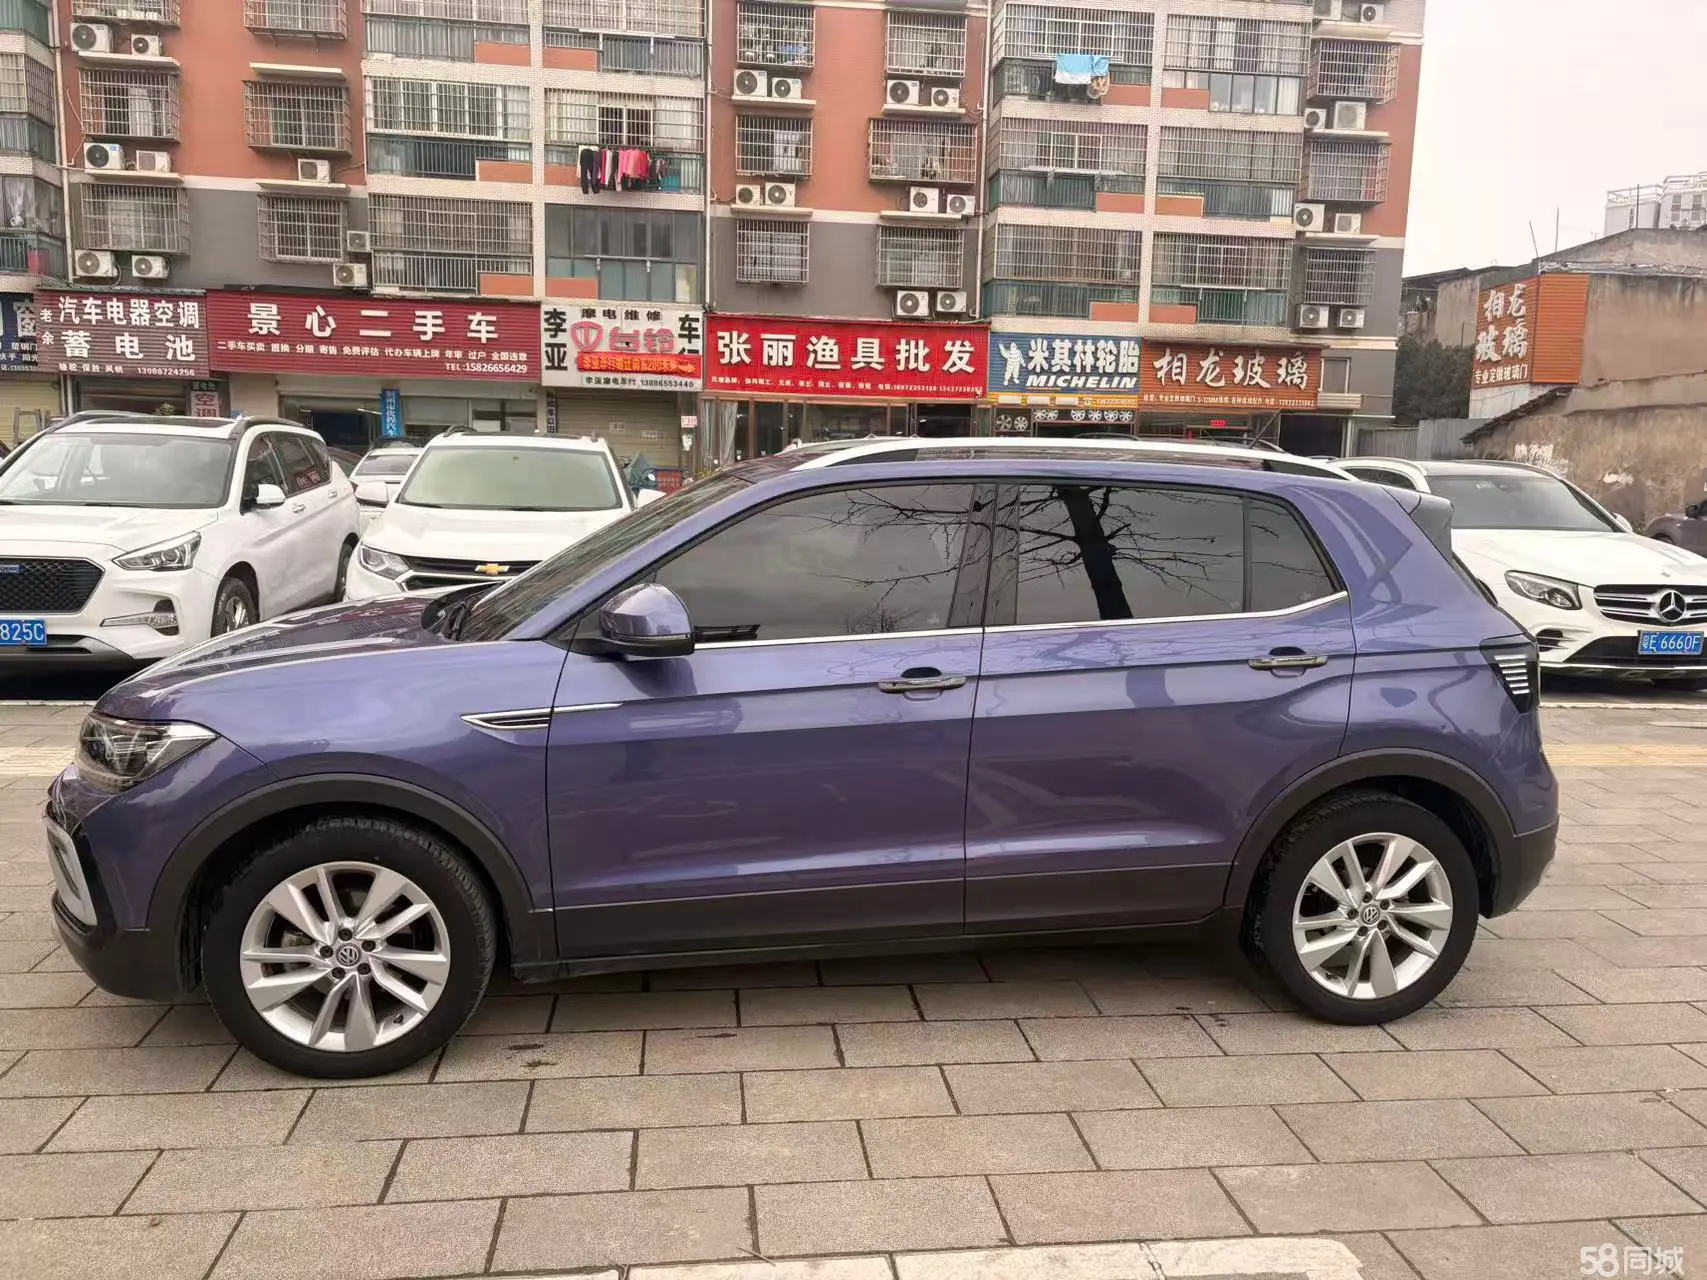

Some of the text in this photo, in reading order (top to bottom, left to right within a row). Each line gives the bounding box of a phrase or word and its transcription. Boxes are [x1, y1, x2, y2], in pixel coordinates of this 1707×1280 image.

[58, 296, 200, 329] 汽车电器空调
[581, 308, 662, 322] 摩电维修
[1482, 283, 1527, 321] 相龙
[40, 308, 55, 345] 老余
[247, 302, 498, 344] 景心二手车
[543, 308, 568, 371] 李亚
[608, 326, 675, 354] 台铃
[1475, 318, 1528, 362] 玻璃
[60, 329, 196, 361] 蓄电池
[217, 341, 528, 361] 二手车买卖 置换 分期 寄售 免费评估 代办车辆上牌 年审 过户 全国违章
[716, 330, 976, 374] 张丽渔具批发
[1027, 338, 1140, 374] 米其林轮胎
[585, 376, 636, 386] 李亚摩电车行
[1025, 375, 1137, 388] MICHELIN
[1153, 346, 1309, 391] 相龙玻璃
[1473, 364, 1528, 385] 专业定做玻璃门
